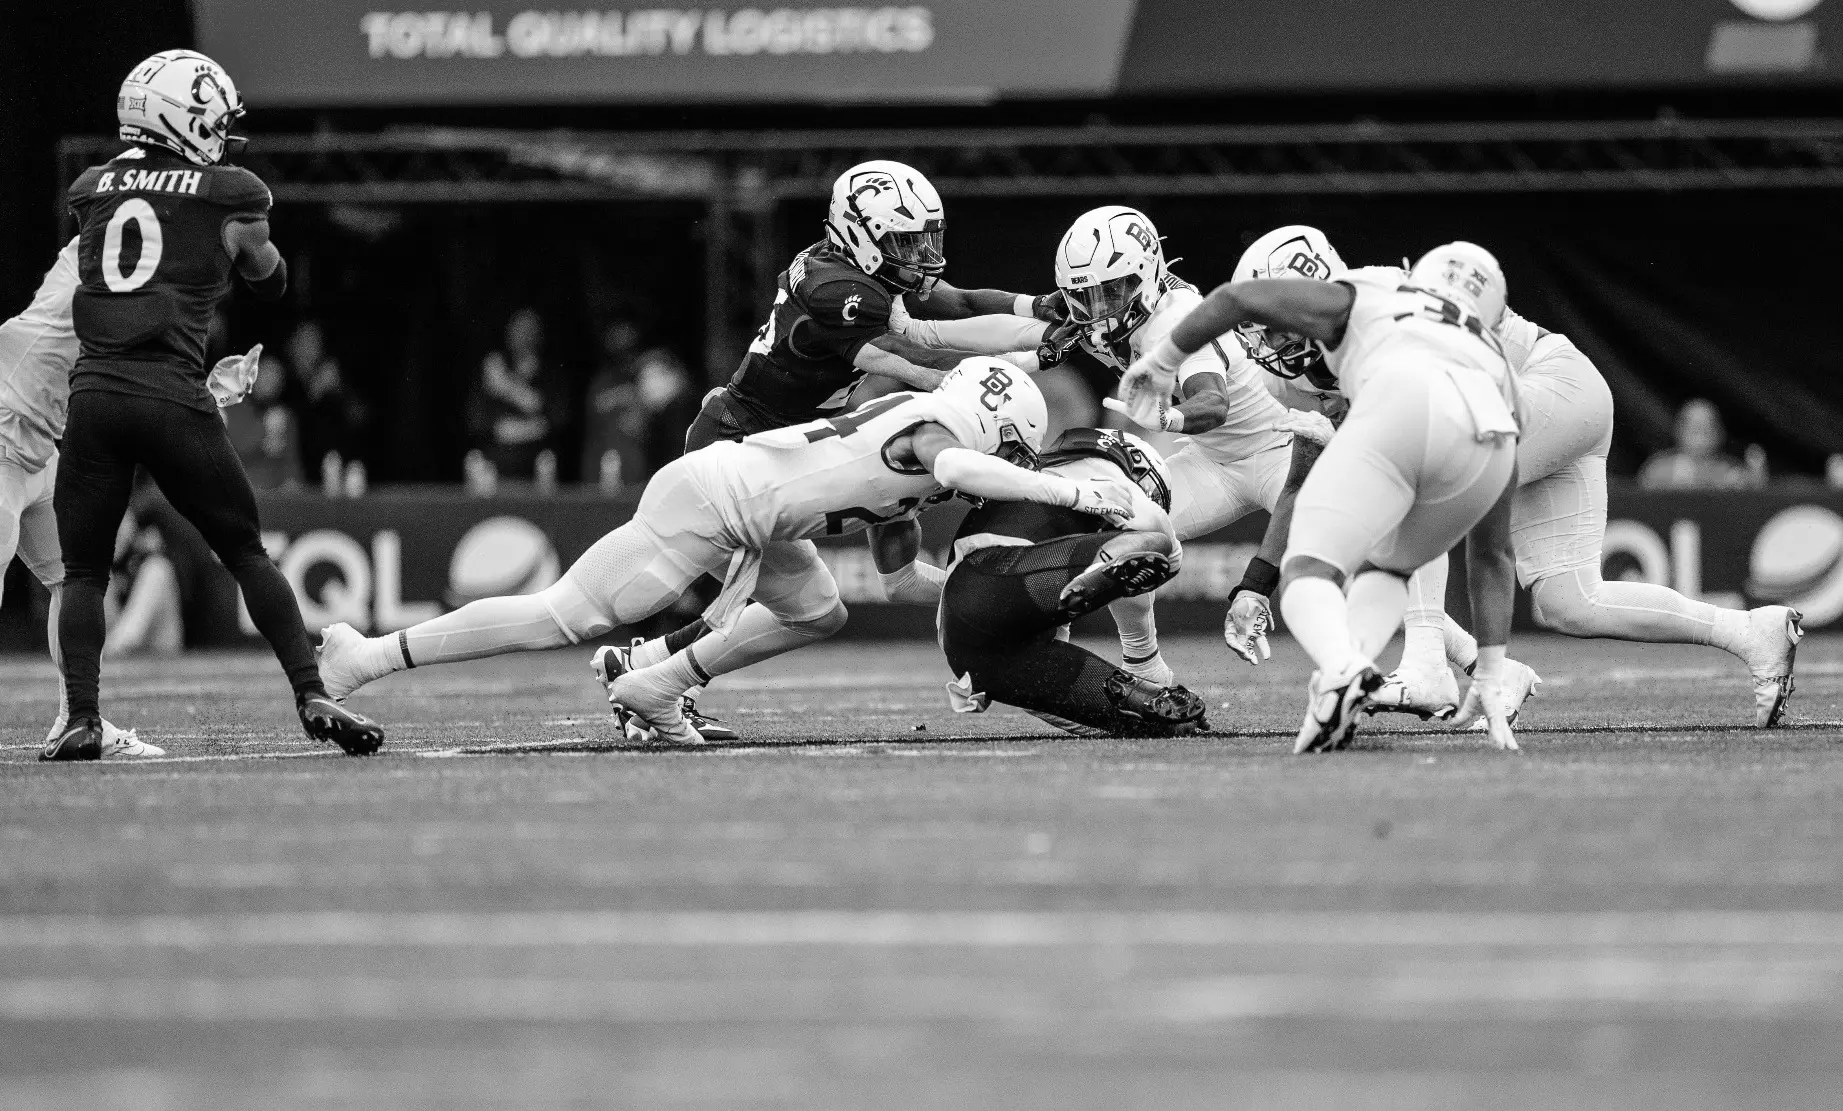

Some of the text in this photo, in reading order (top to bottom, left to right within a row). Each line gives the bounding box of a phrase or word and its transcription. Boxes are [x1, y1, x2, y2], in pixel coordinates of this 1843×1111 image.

[360, 6, 934, 59] TOTAL QUALITY LOGISTICS
[96, 169, 203, 195] B. SMITH
[102, 198, 163, 293] 0
[1070, 275, 1089, 285] BEARS
